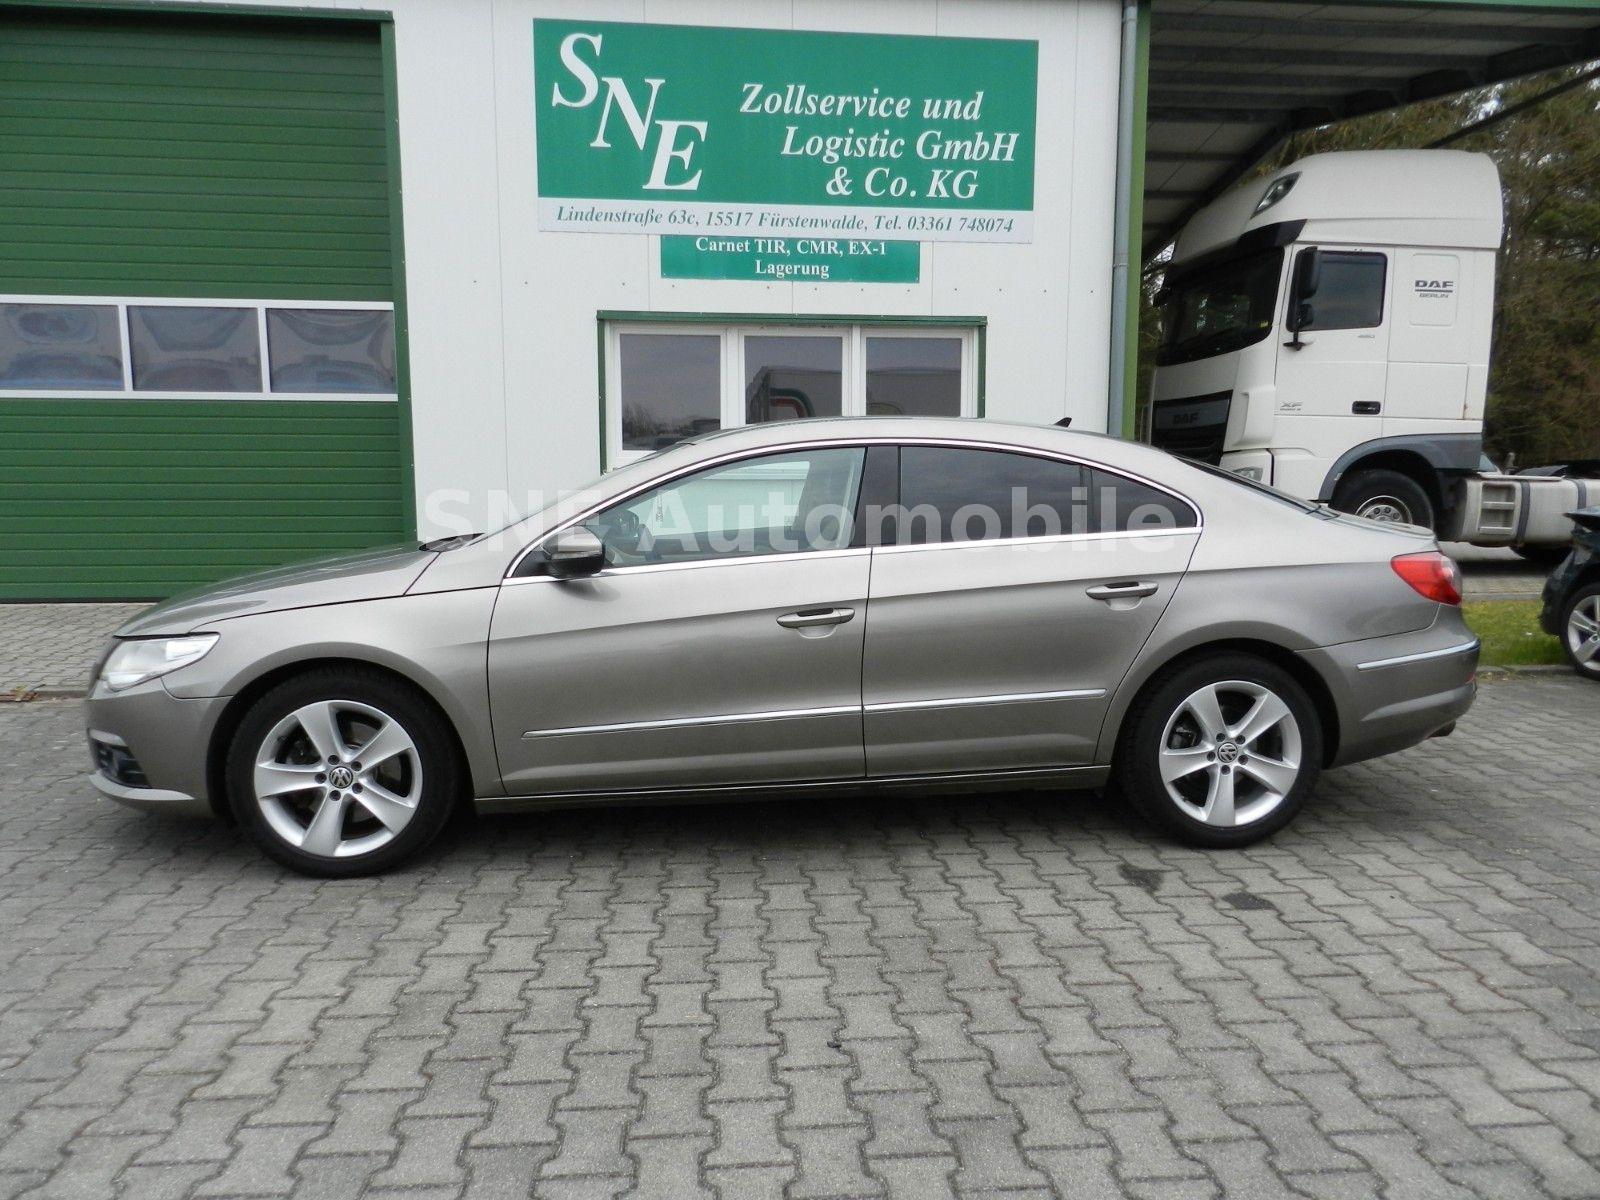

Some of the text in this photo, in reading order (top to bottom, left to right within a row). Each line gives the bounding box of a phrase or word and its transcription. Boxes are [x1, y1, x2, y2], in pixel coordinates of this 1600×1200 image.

[552, 32, 709, 191] SNE
[739, 82, 984, 121] Zollservice und
[780, 125, 1019, 165] Logistic GmbH
[825, 166, 978, 199] & Co. KG
[556, 205, 1014, 233] Lindenstraße 63c, 15517 Fürstenwalde, Tel. 03361 748074
[695, 236, 887, 258] Carnet TIR, CMR, EX-1
[755, 259, 830, 279] Lagerung
[1414, 280, 1454, 289] DAF
